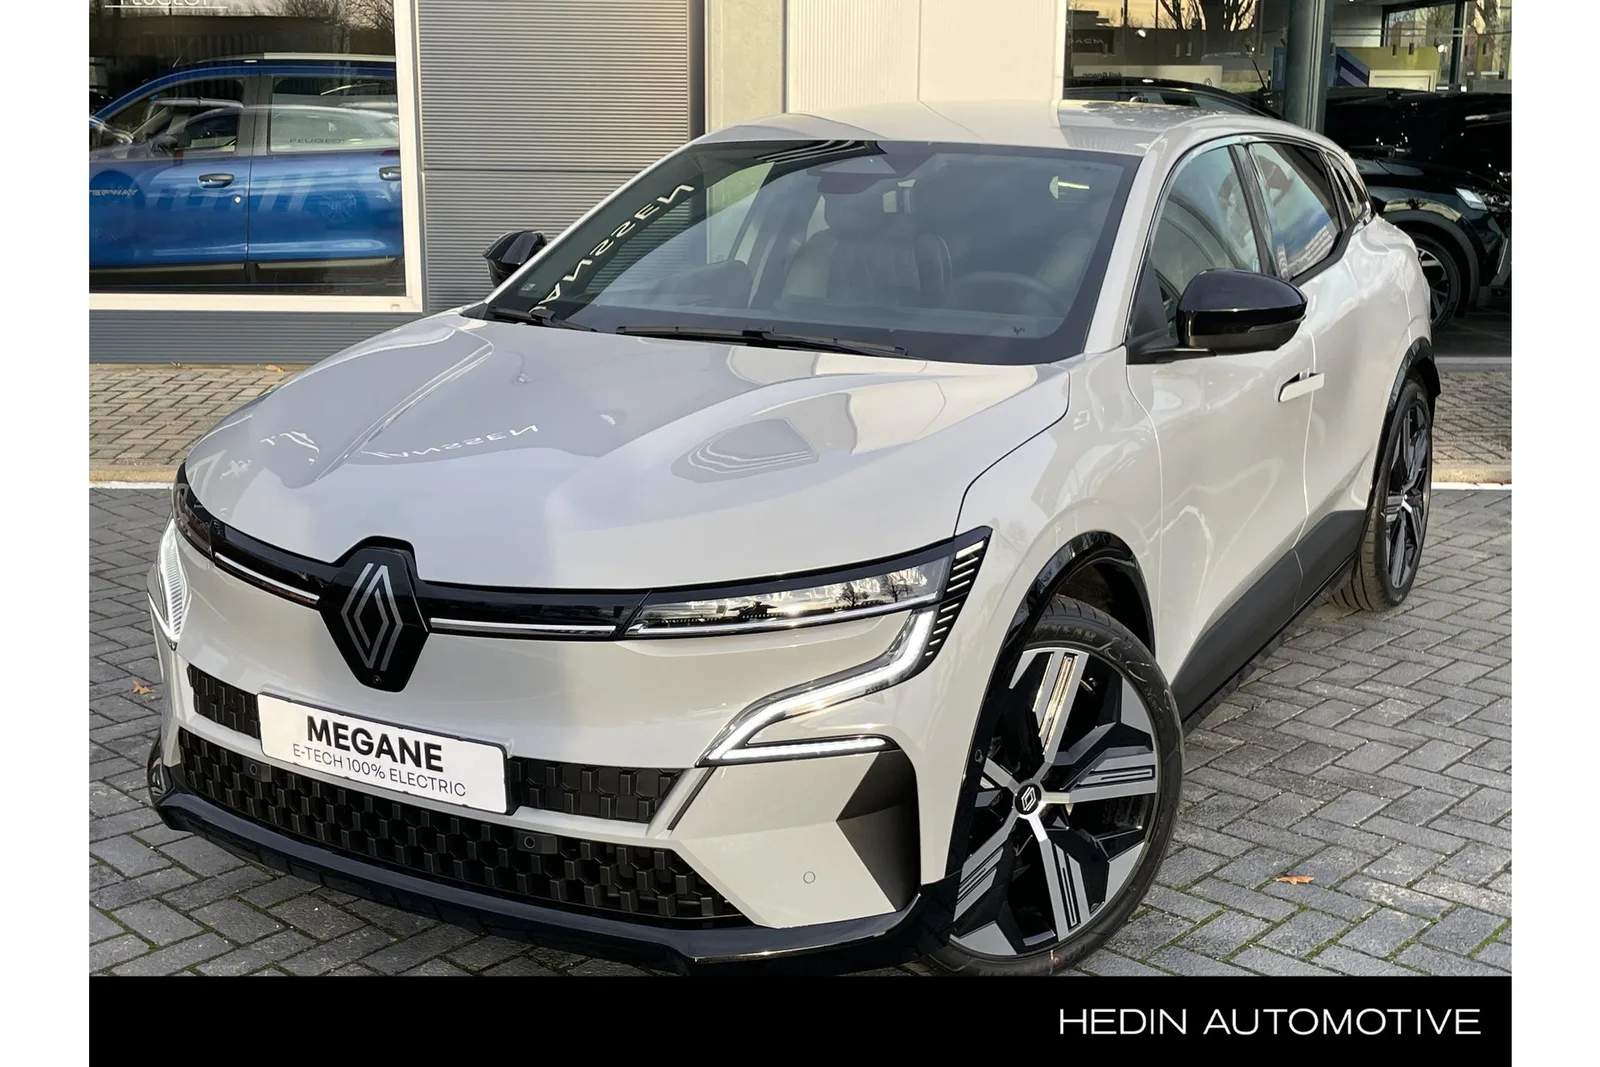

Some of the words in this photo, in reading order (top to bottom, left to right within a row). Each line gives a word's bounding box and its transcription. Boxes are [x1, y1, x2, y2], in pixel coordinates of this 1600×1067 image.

[292, 743, 344, 769] E-TECH
[346, 757, 386, 780] 100%
[390, 768, 467, 797] ELECTRIC
[307, 715, 444, 773] MEGANE
